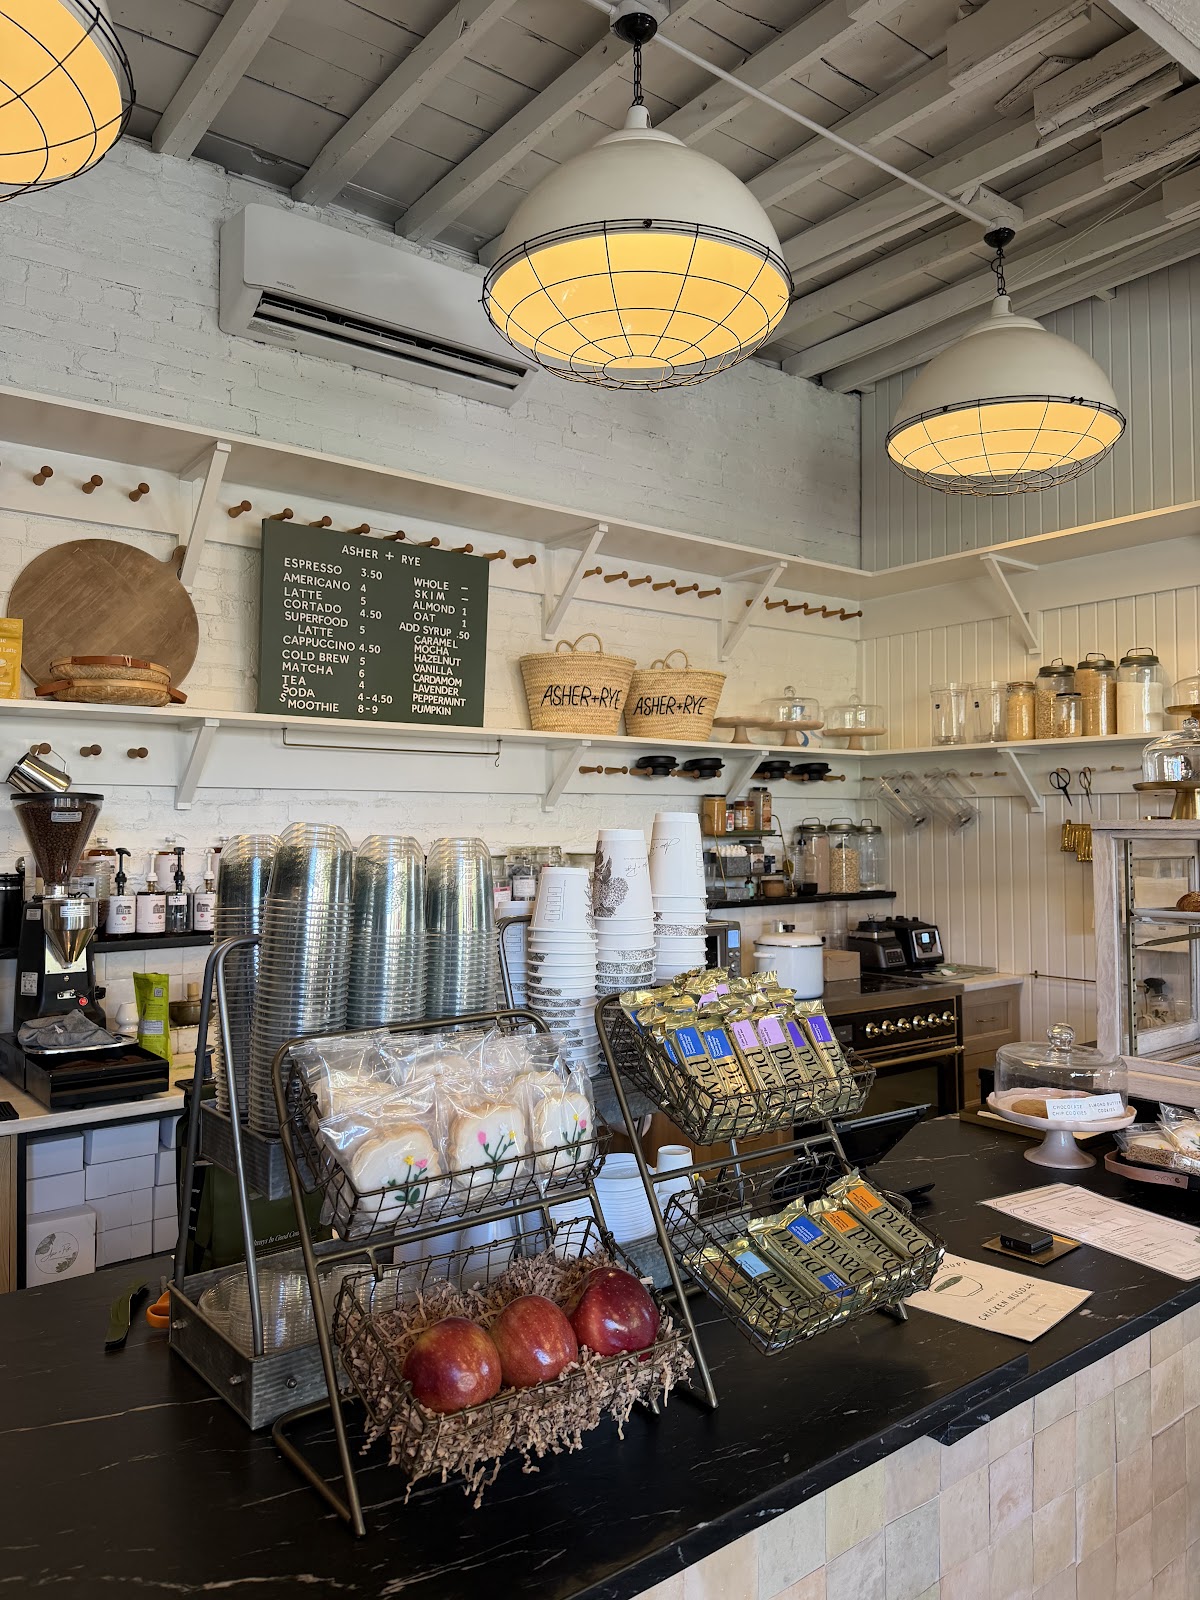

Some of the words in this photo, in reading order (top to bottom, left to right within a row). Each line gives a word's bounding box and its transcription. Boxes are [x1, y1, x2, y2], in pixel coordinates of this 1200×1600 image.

[342, 545, 378, 559] ASHER
[385, 551, 394, 560] +
[402, 555, 421, 566] RYE
[284, 558, 342, 574] ESPRESSO
[361, 569, 382, 580] 3.50
[284, 573, 350, 590] AMERICANO
[361, 584, 366, 592] 4
[414, 577, 449, 590] WHOLE
[284, 587, 322, 600] LATTE
[361, 597, 366, 605] 5
[415, 590, 445, 601] SKIM
[284, 599, 341, 614] CORTADO
[360, 609, 382, 619] 4.50
[413, 601, 455, 614] ALMOND
[285, 612, 348, 627] SUPERFOOD
[414, 612, 435, 622] OAT
[298, 625, 333, 637] LATTE
[359, 626, 365, 634] 5
[399, 622, 420, 632] ADD
[423, 625, 451, 636] SYRUP
[457, 631, 470, 640] .50
[283, 636, 355, 651] CAPPUCCINO
[359, 644, 380, 654] 4.50
[414, 635, 458, 648] CARAMEL
[414, 645, 449, 656] MOCHA
[282, 650, 315, 660] COLD
[319, 653, 350, 663] BREW
[359, 657, 365, 665] 5
[414, 654, 461, 666] HAZELNUT
[282, 663, 333, 675] MATCHA
[359, 669, 365, 678] 6
[414, 664, 453, 675] VANILLA
[282, 675, 306, 685] TEA
[359, 681, 364, 689] 4
[412, 674, 462, 687] CARDAMOM
[282, 684, 315, 698] SODA
[413, 684, 459, 696] LAVENDER
[541, 684, 622, 711] ASHER+RYE
[279, 693, 339, 712] SMOOTHIE
[413, 694, 466, 706] PEPPERMINT
[633, 696, 708, 716] ASHER+RYE
[412, 705, 451, 715] PUMPKIN
[744, 1048, 786, 1108] David
[767, 1044, 810, 1102] David
[716, 1057, 755, 1116] David
[872, 1207, 928, 1255] David
[771, 1229, 826, 1274] David
[847, 1228, 898, 1271] David
[812, 1236, 870, 1284] David
[757, 1270, 819, 1322] David
[978, 1300, 1009, 1321] CHICKEN
[1008, 1282, 1035, 1301] NOODLE
